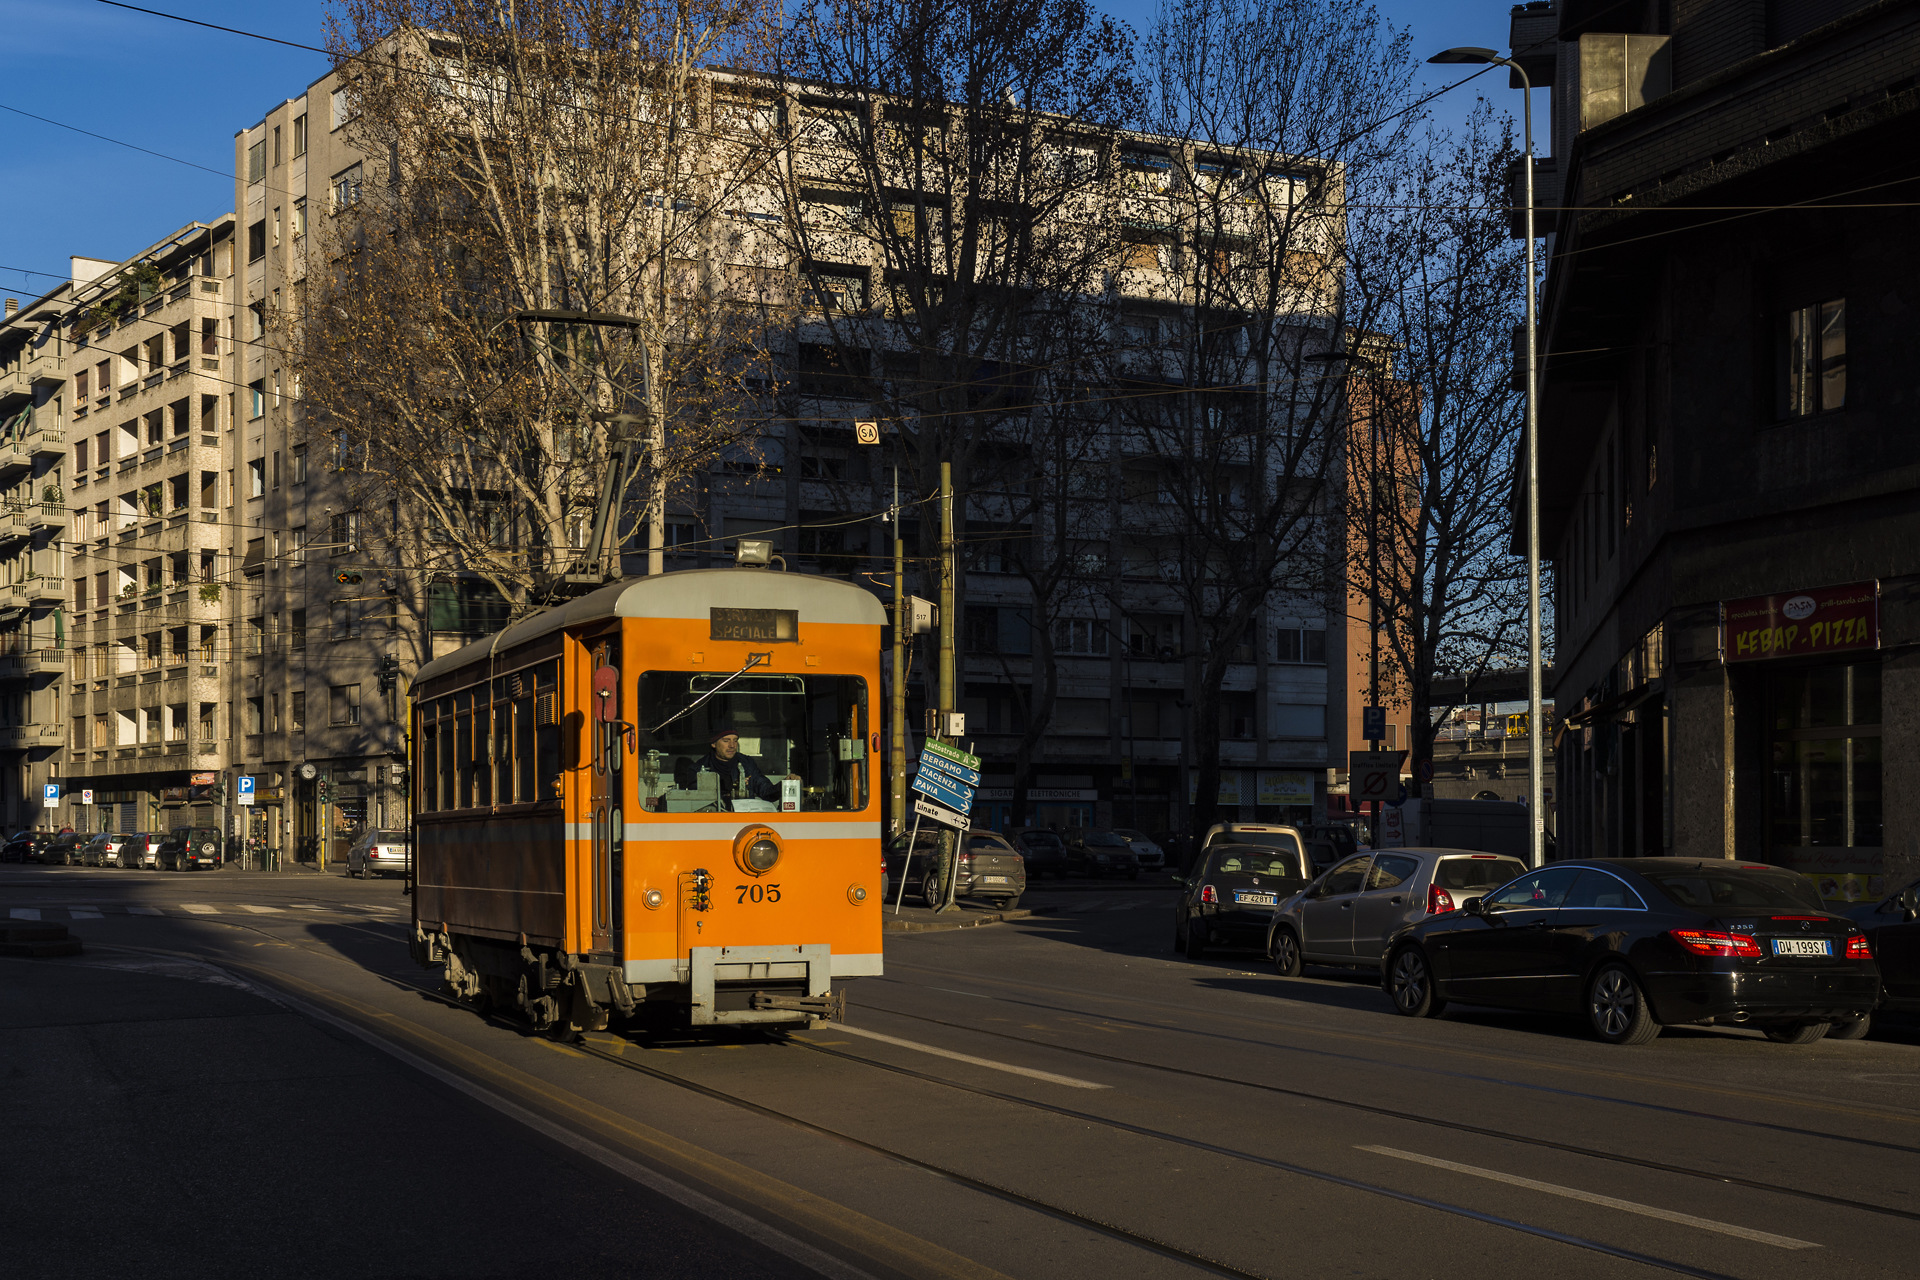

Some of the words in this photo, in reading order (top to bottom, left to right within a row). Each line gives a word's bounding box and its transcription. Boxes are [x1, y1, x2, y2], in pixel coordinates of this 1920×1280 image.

[861, 428, 874, 438] SA
[715, 626, 775, 639] SPECIALE
[1736, 625, 1798, 655] KEBAP
[1809, 616, 1868, 648] PIZZA
[1367, 708, 1381, 726] P
[923, 753, 962, 775] BERGAMO
[921, 765, 957, 790] PIACENZA
[46, 786, 57, 797] P
[241, 779, 252, 792] P
[915, 779, 938, 796] PAVIA
[1030, 790, 1081, 798] ELETTRONICHE
[917, 803, 939, 816] Linate
[735, 884, 781, 904] 705
[1779, 941, 1792, 953] DW
[1796, 941, 1825, 954] 199SY
